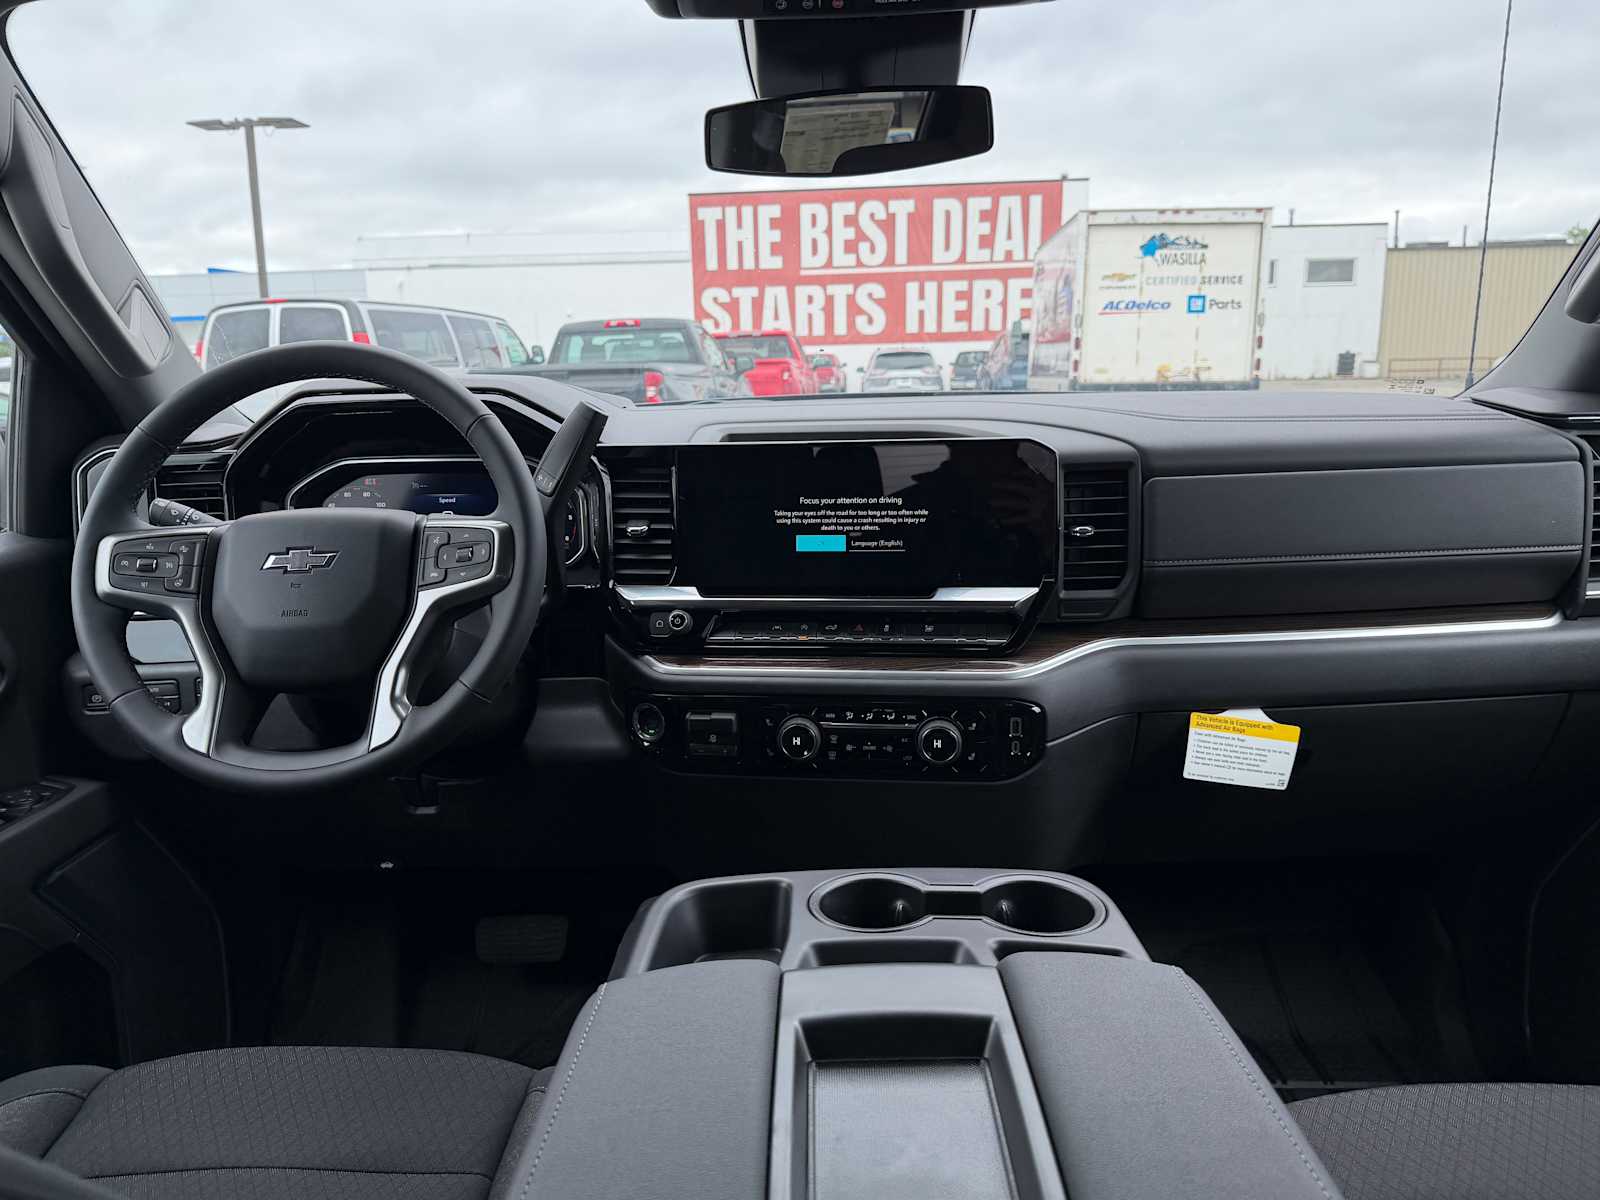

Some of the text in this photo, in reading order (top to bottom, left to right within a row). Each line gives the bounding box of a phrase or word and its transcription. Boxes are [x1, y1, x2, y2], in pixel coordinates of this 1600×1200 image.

[697, 204, 783, 271] THE
[800, 199, 915, 269] BEST
[1160, 252, 1207, 266] WASILLA
[1145, 274, 1243, 286] CERTIFIED SERVICE
[700, 282, 887, 336] STARTS
[1103, 300, 1171, 311] ACDelco
[1209, 299, 1242, 310] Parts
[438, 496, 456, 504] Speed
[800, 497, 820, 505] Focus
[820, 498, 836, 506] your
[879, 496, 903, 505] driving
[868, 509, 880, 517] long
[898, 508, 914, 516] often
[776, 517, 791, 525] using
[802, 517, 821, 525] system
[873, 517, 897, 525] resulting
[904, 517, 919, 525] injury
[281, 609, 309, 617] AIRBAG
[933, 739, 942, 748] HI
